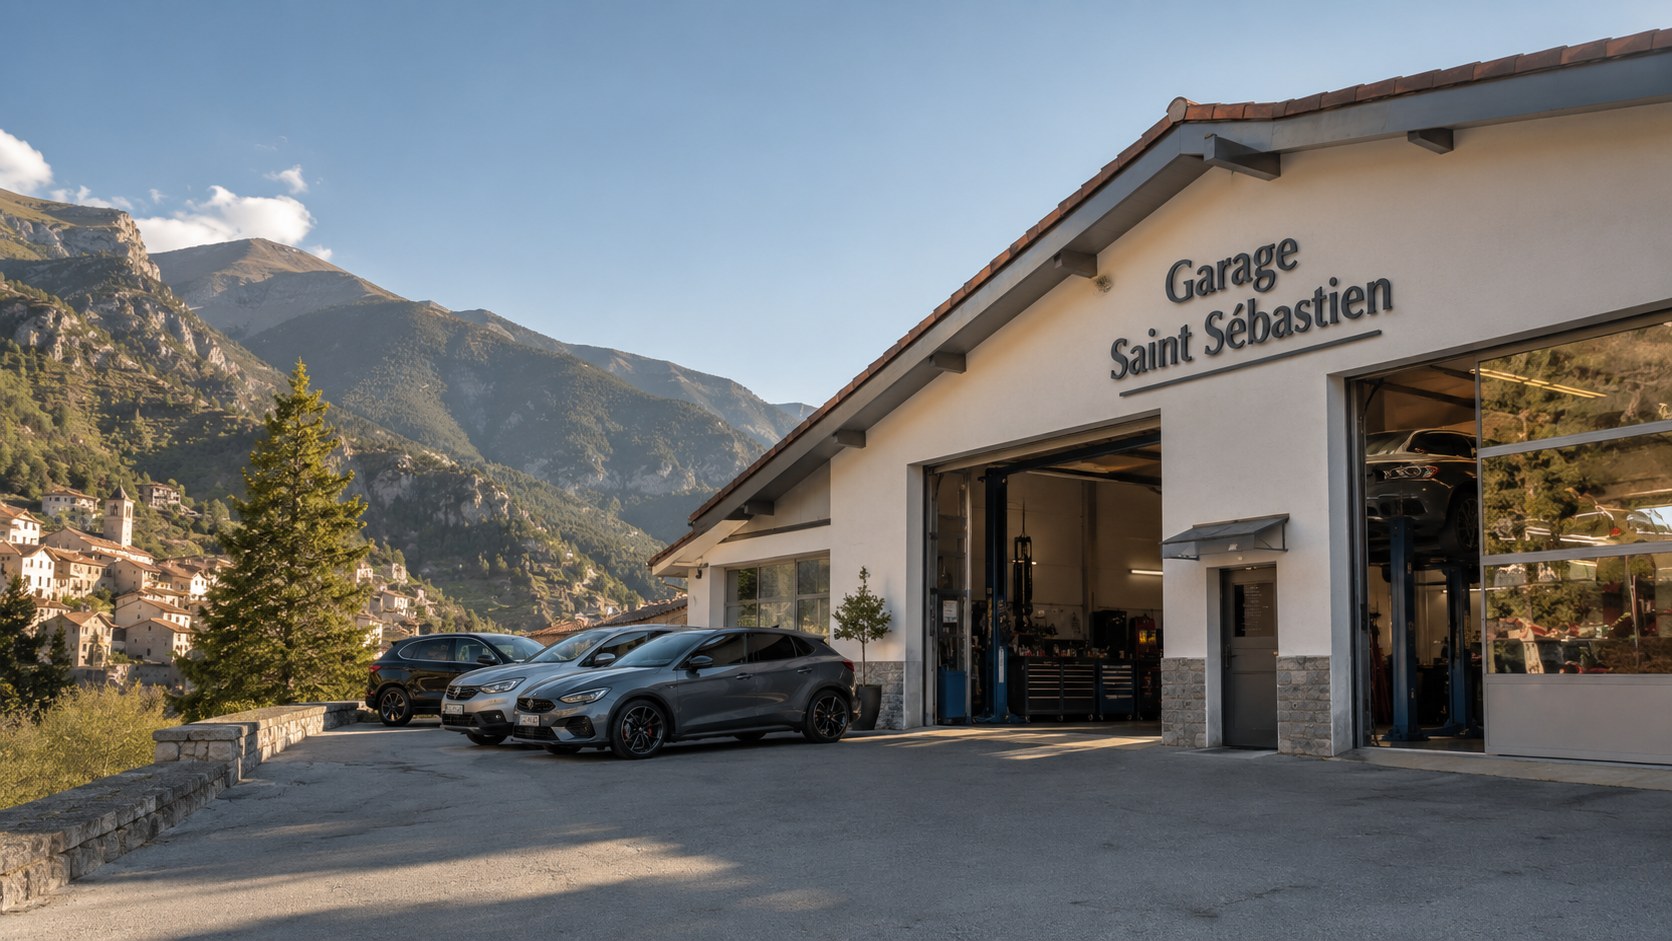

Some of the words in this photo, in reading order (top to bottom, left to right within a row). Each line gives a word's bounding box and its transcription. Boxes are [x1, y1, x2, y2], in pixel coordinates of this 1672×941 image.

[1165, 237, 1298, 303] Garage
[1110, 324, 1193, 380] Saint
[1204, 277, 1393, 356] Sébastien
